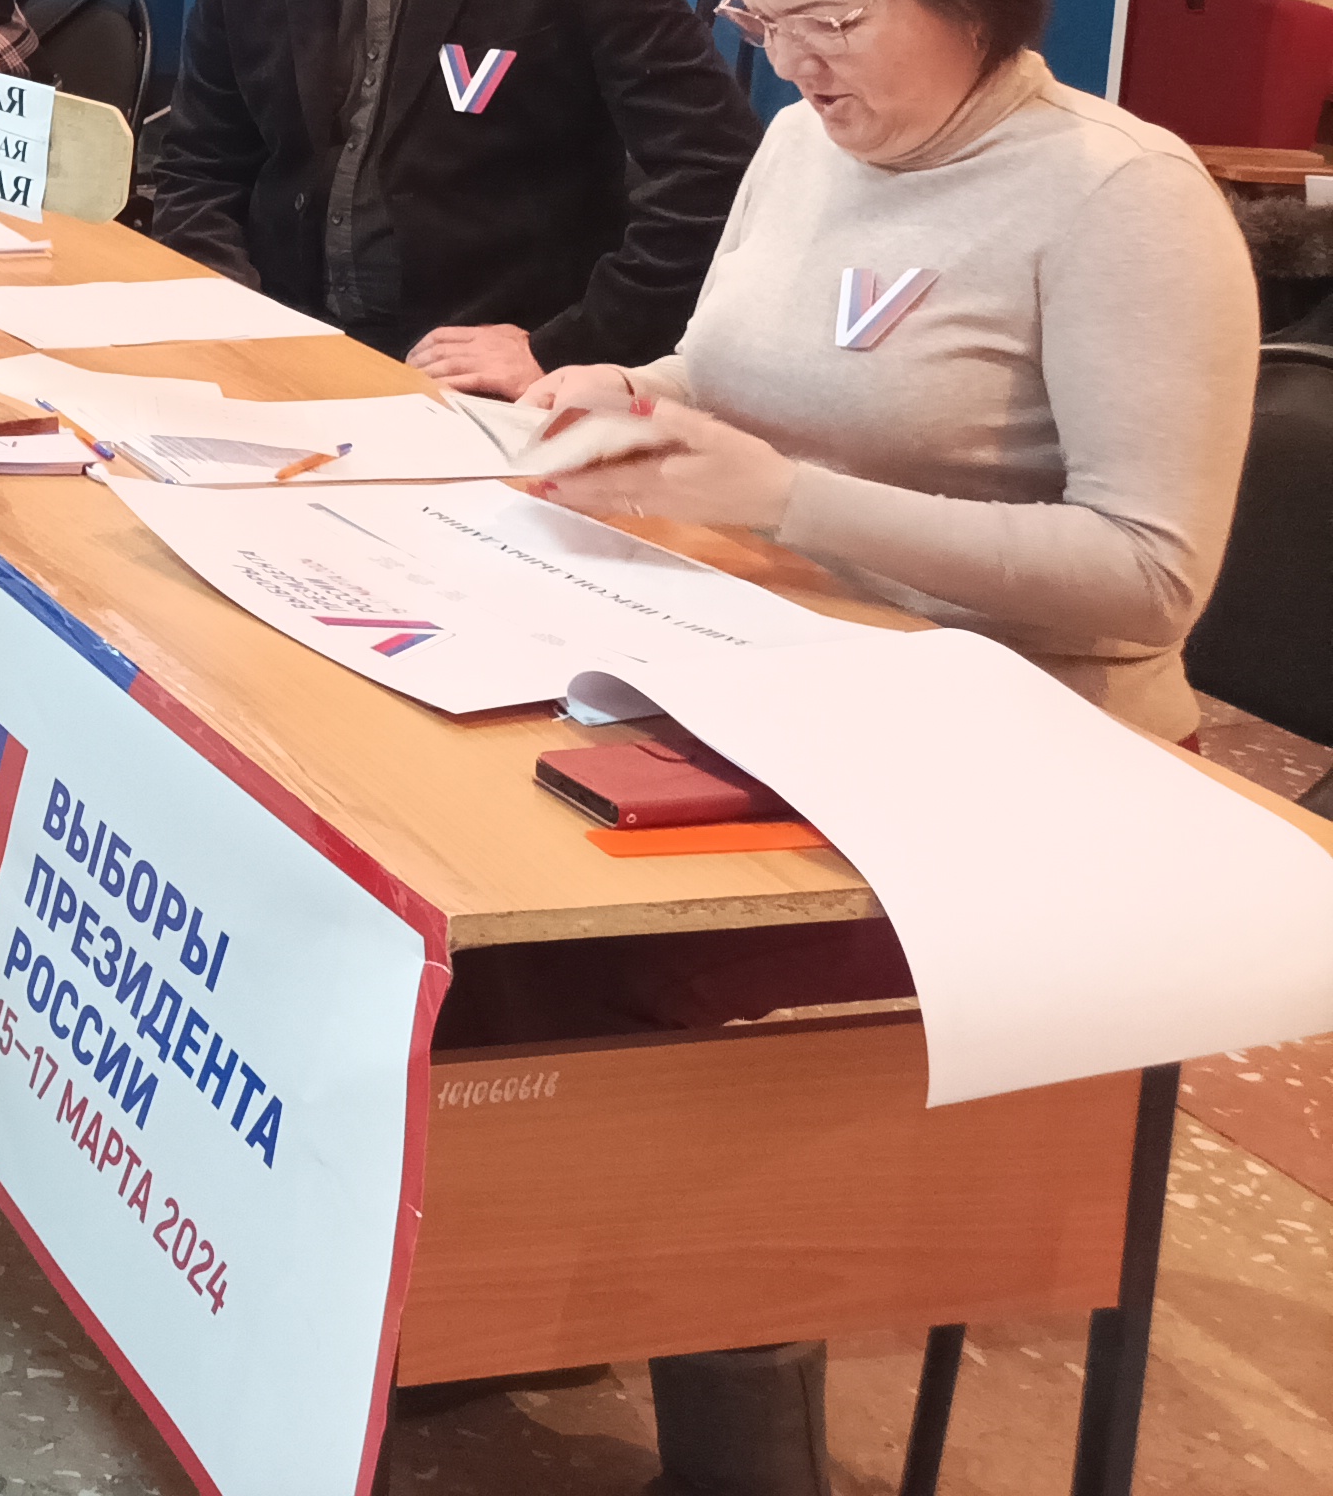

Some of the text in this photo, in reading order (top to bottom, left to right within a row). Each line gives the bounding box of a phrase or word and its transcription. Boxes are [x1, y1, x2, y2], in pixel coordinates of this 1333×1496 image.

[42, 777, 231, 993] ВЫБОРЫ
[3, 927, 161, 1132] РОССИИ
[23, 853, 284, 1170] ПРЕЗИДЕНТА
[56, 1089, 157, 1233] МАРТА
[153, 1196, 231, 1317] 2024
